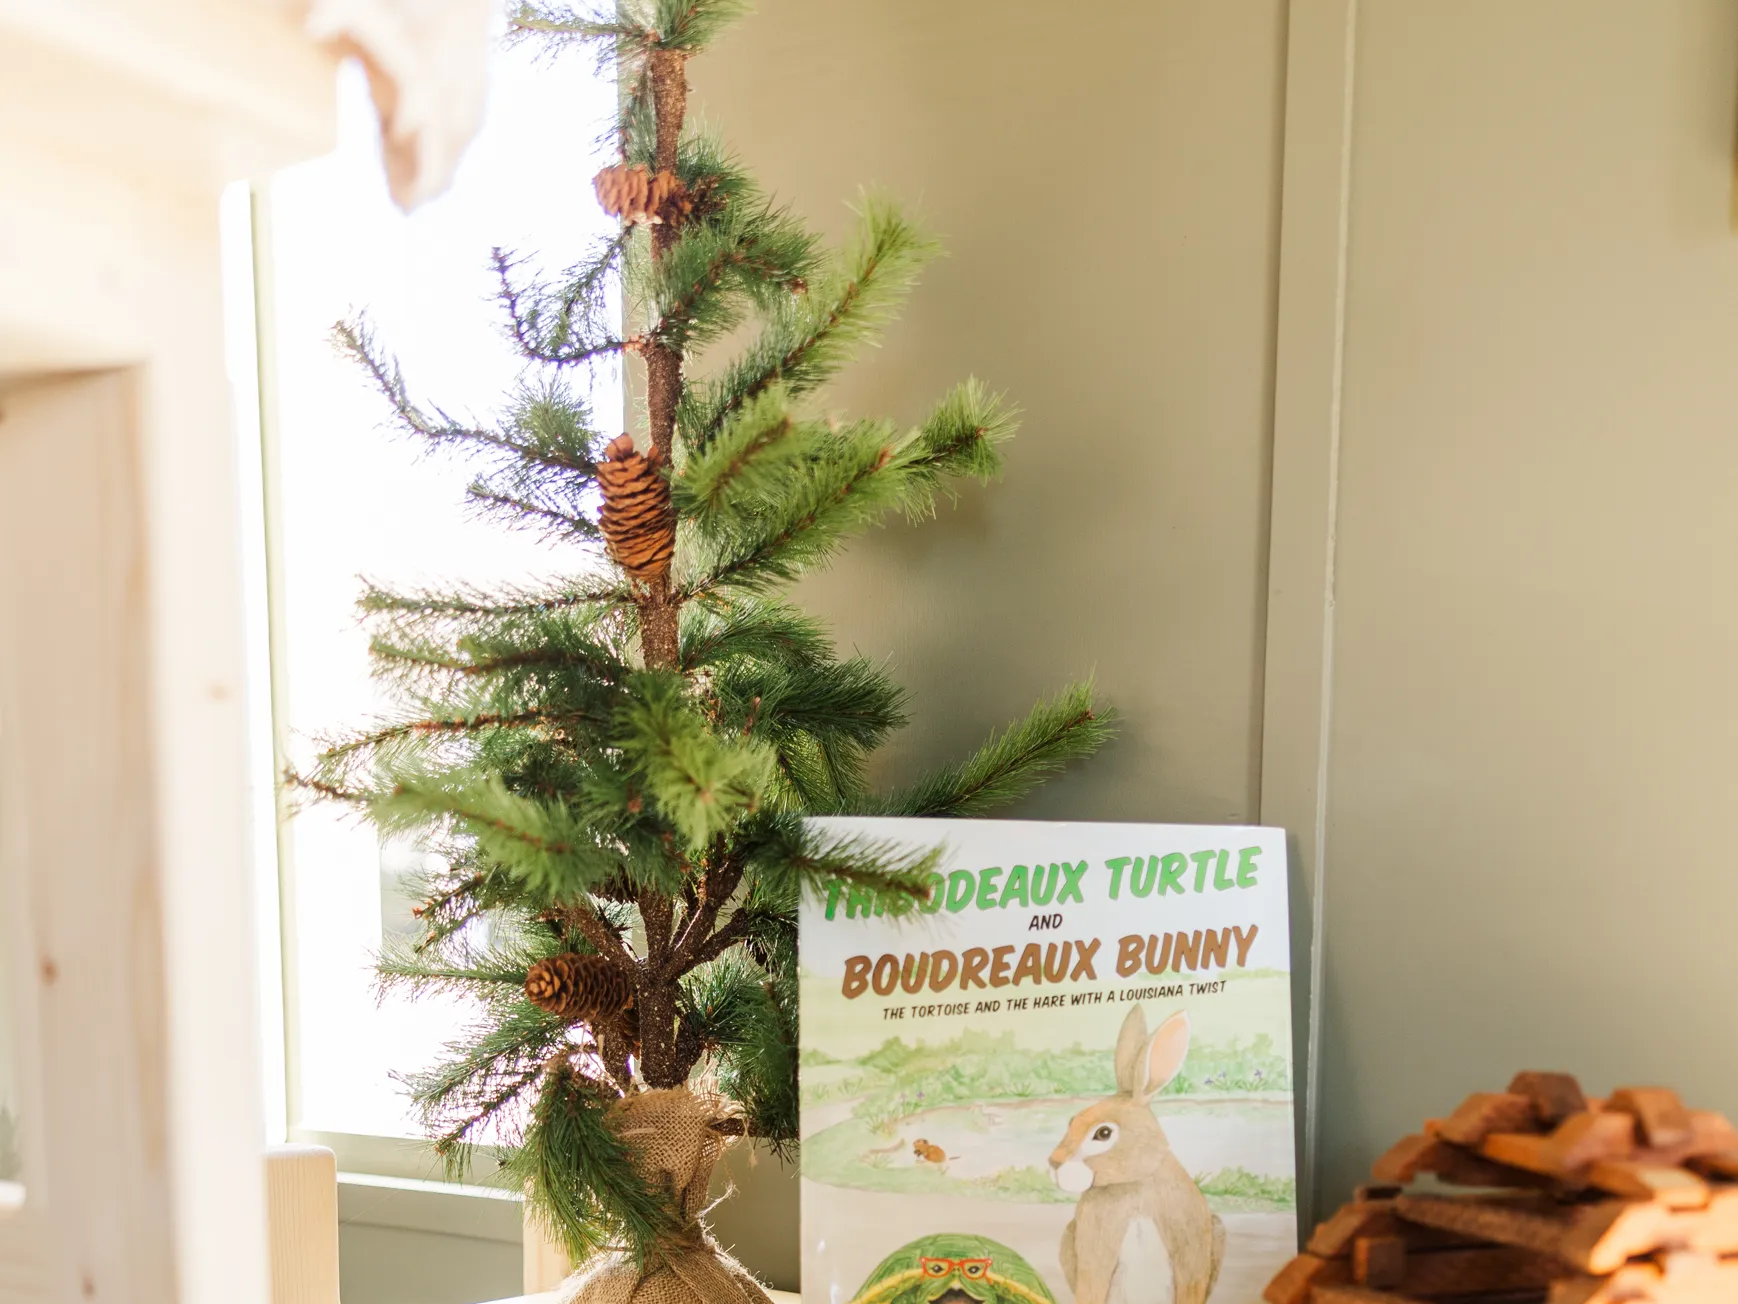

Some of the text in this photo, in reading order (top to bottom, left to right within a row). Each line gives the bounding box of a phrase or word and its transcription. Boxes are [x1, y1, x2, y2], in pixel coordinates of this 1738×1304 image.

[1105, 846, 1262, 900] TURTLE
[1028, 913, 1063, 931] AND
[841, 924, 1259, 999] BOUDREAUX BUNNY
[883, 980, 1227, 1020] THE TORTOISE AND THE HARE WITH A LOUISIANA TWIST
